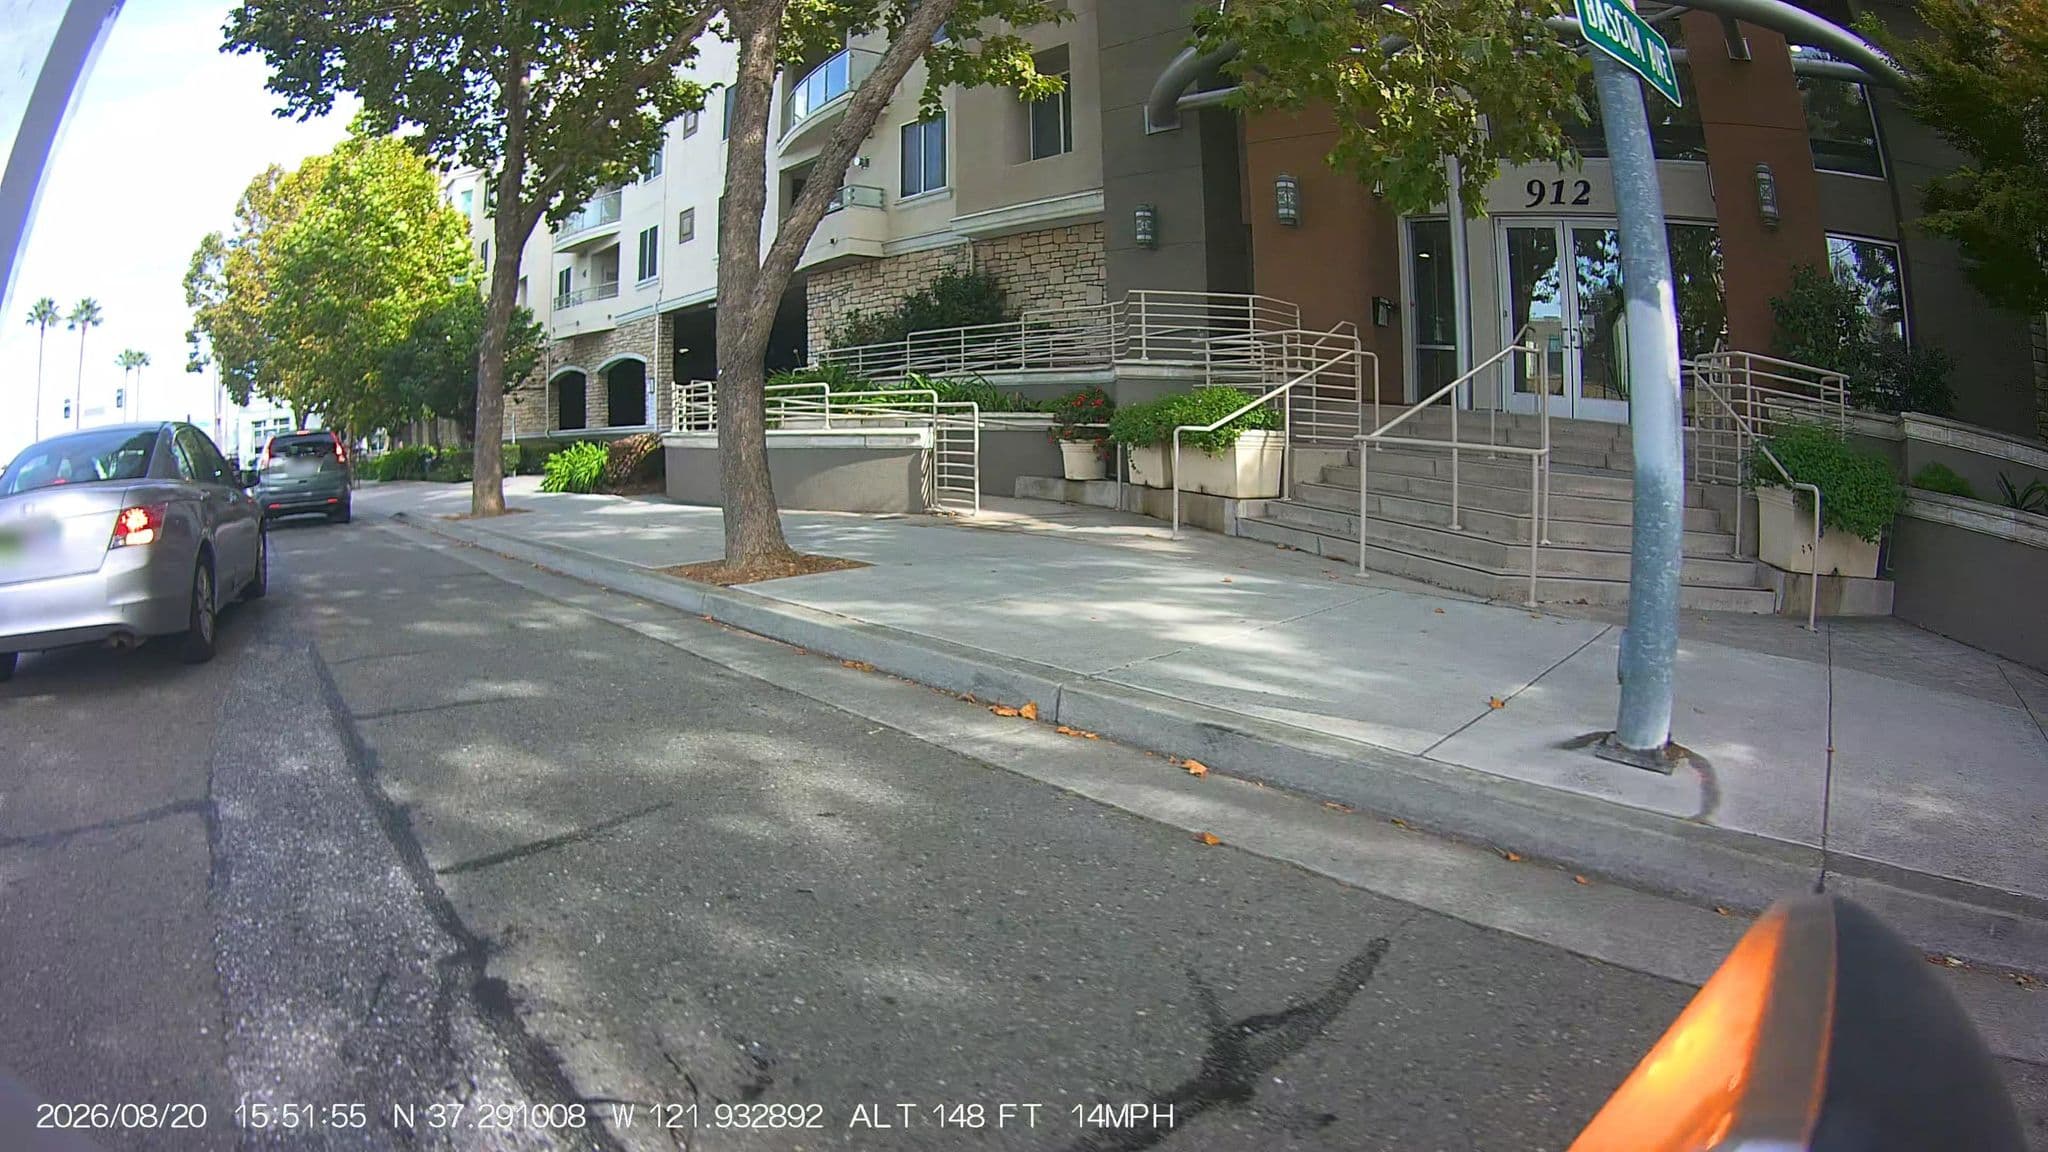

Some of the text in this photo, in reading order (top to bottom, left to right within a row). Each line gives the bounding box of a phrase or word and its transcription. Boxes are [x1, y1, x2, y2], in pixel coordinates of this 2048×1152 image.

[1584, 0, 1672, 86] BASCOM AVE
[1525, 179, 1591, 208] 912
